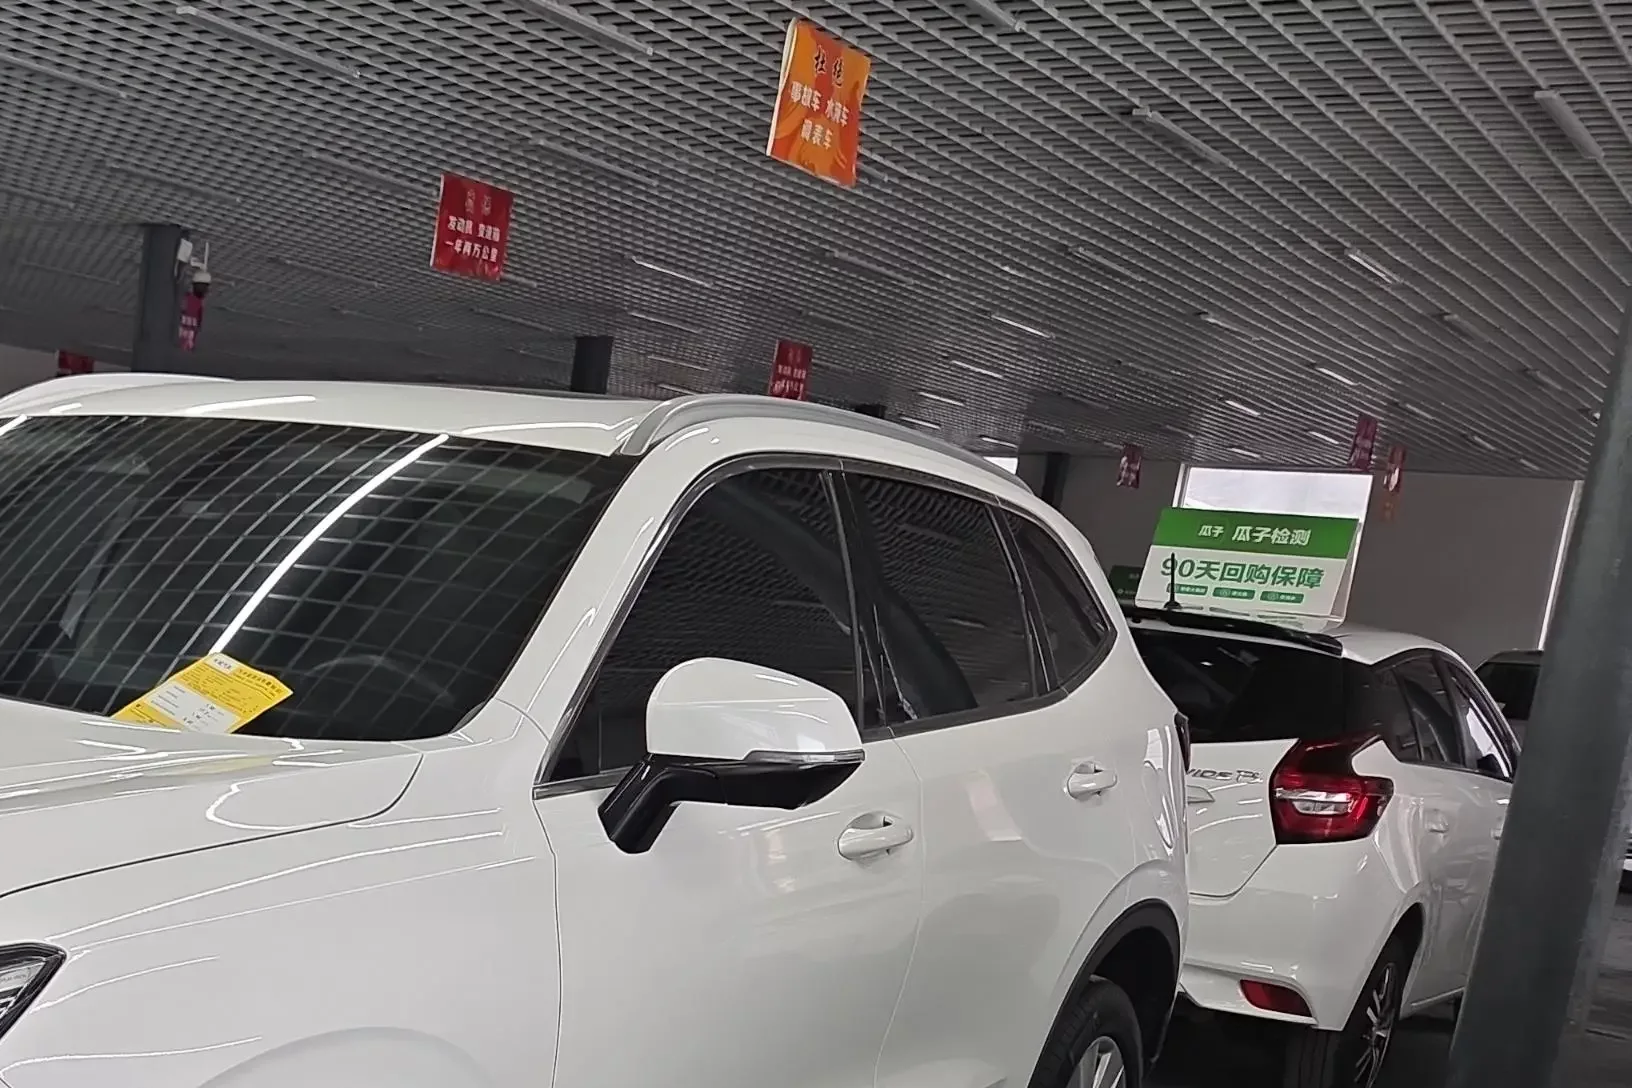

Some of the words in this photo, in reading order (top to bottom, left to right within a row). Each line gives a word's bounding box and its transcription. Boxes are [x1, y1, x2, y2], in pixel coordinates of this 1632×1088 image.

[444, 239, 499, 262] 一年两万公里
[1198, 524, 1225, 538] 瓜子
[1231, 526, 1312, 546] 瓜子检测
[1160, 558, 1325, 589] 90天回购保障
